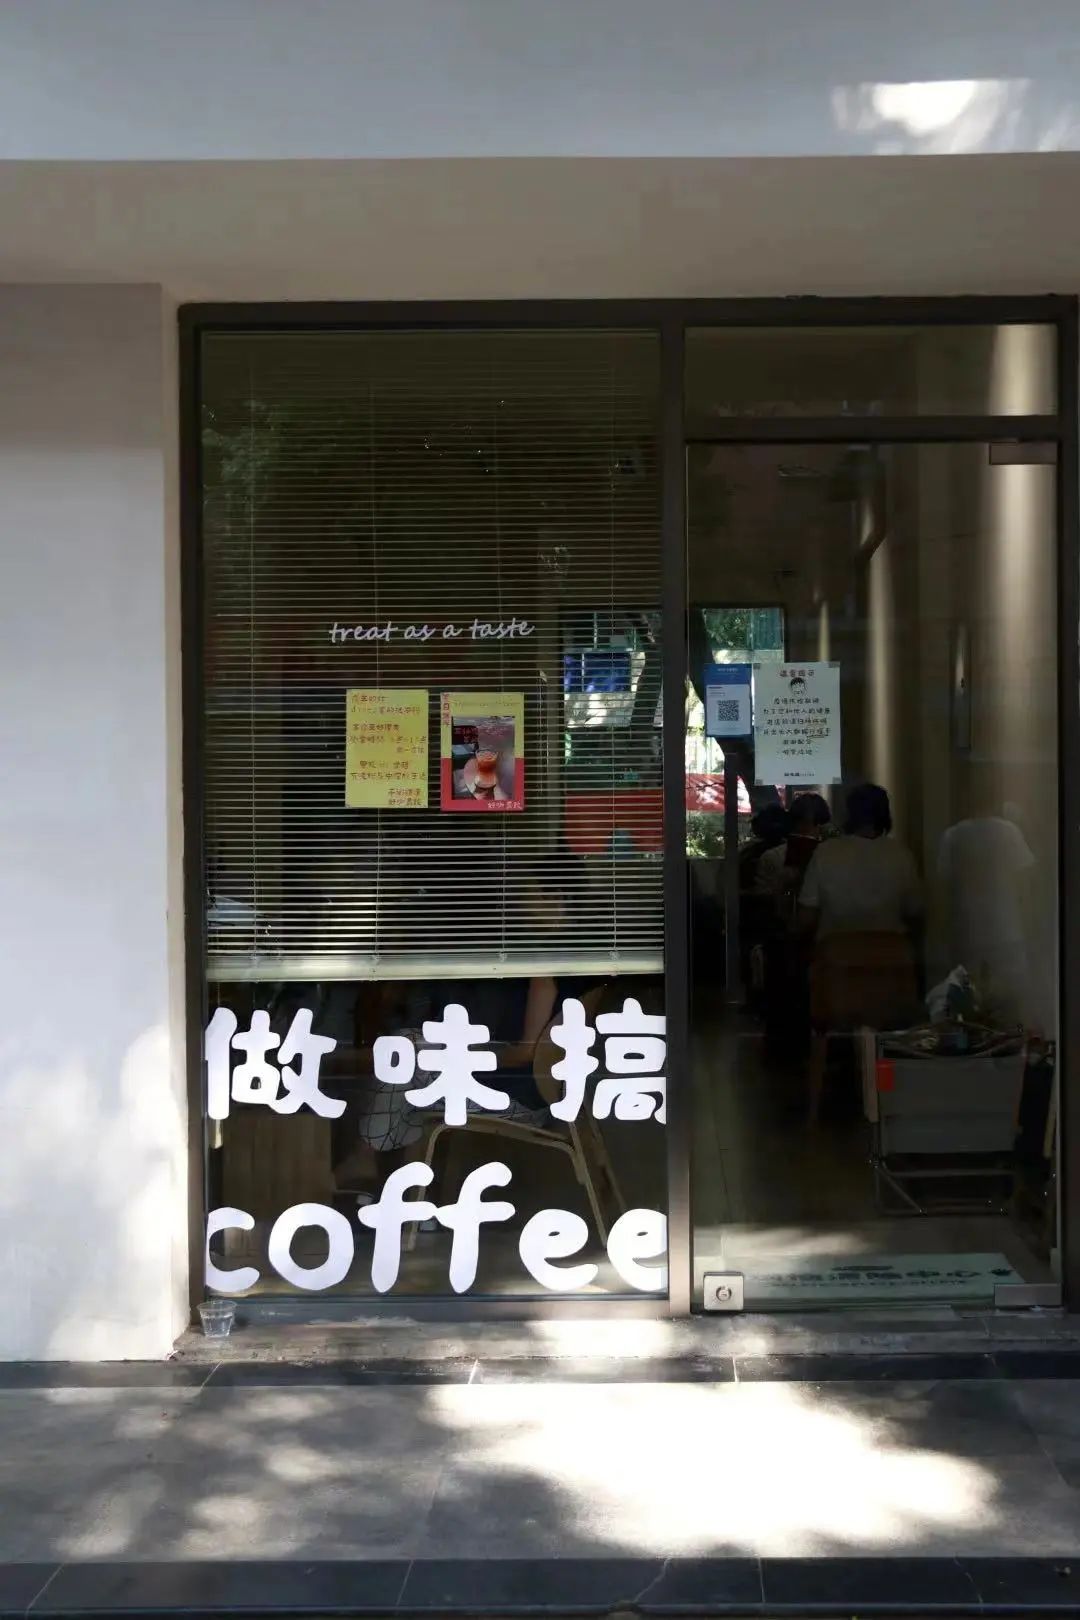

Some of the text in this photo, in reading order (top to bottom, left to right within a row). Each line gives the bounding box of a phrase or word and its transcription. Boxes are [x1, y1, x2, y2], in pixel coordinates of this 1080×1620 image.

[329, 617, 535, 643] treat as a taste
[205, 998, 666, 1125] 做味搞
[205, 1161, 667, 1294] coffee
